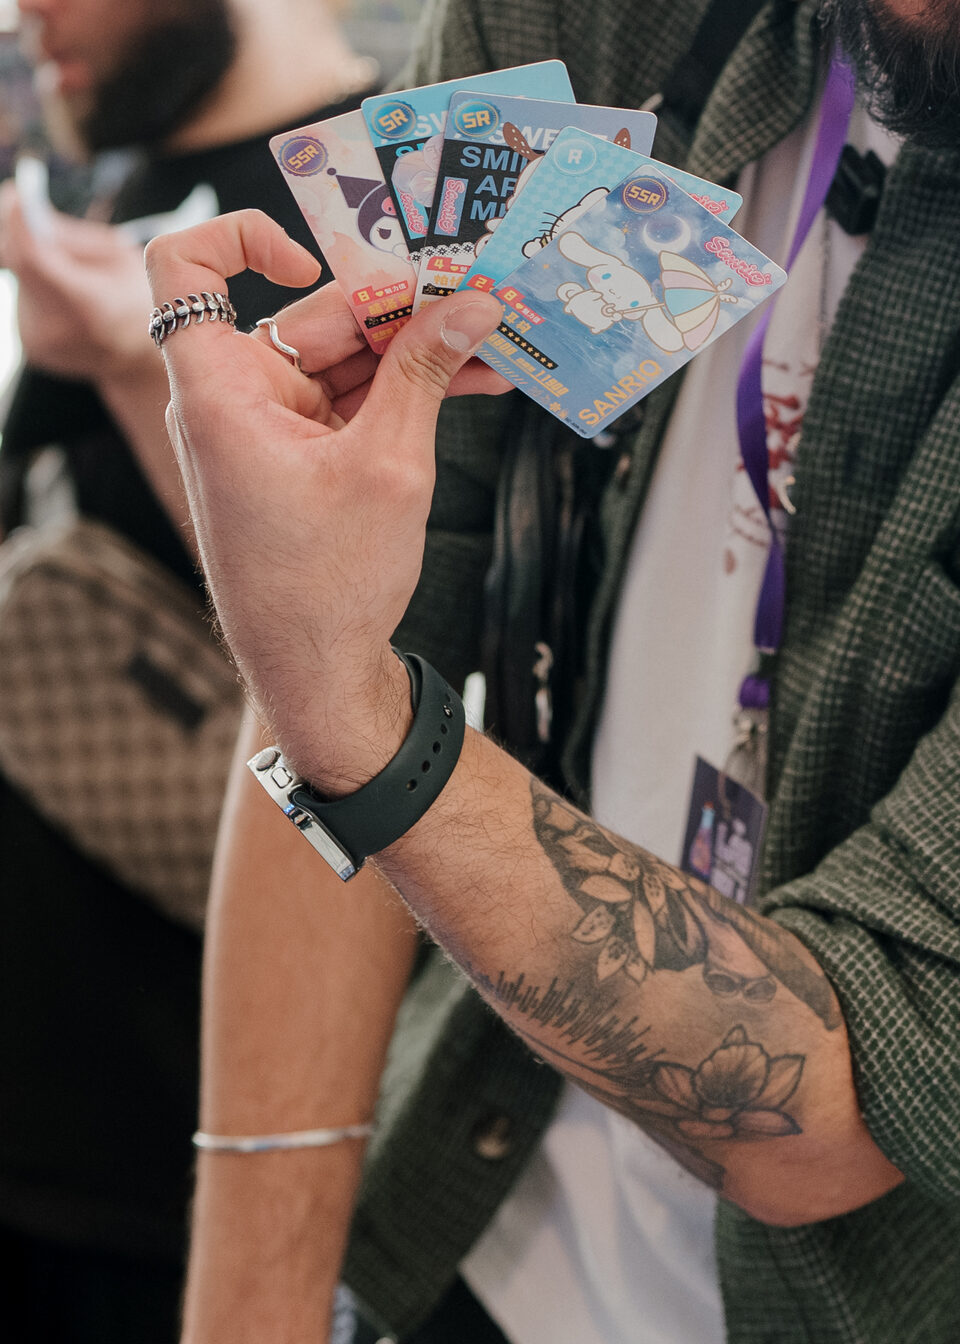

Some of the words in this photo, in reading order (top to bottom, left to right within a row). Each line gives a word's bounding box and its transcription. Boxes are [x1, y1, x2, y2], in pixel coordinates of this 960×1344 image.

[378, 109, 408, 132] SR
[462, 110, 490, 129] SR
[288, 144, 319, 169] SSR
[567, 148, 583, 165] R
[628, 185, 662, 206] SSR
[438, 179, 466, 234] Sanrio
[434, 258, 445, 270] 4
[704, 236, 772, 286] Sanrio
[475, 276, 488, 288] 2
[357, 290, 371, 303] 8
[503, 289, 518, 302] 8
[578, 359, 661, 426] SANRIO
